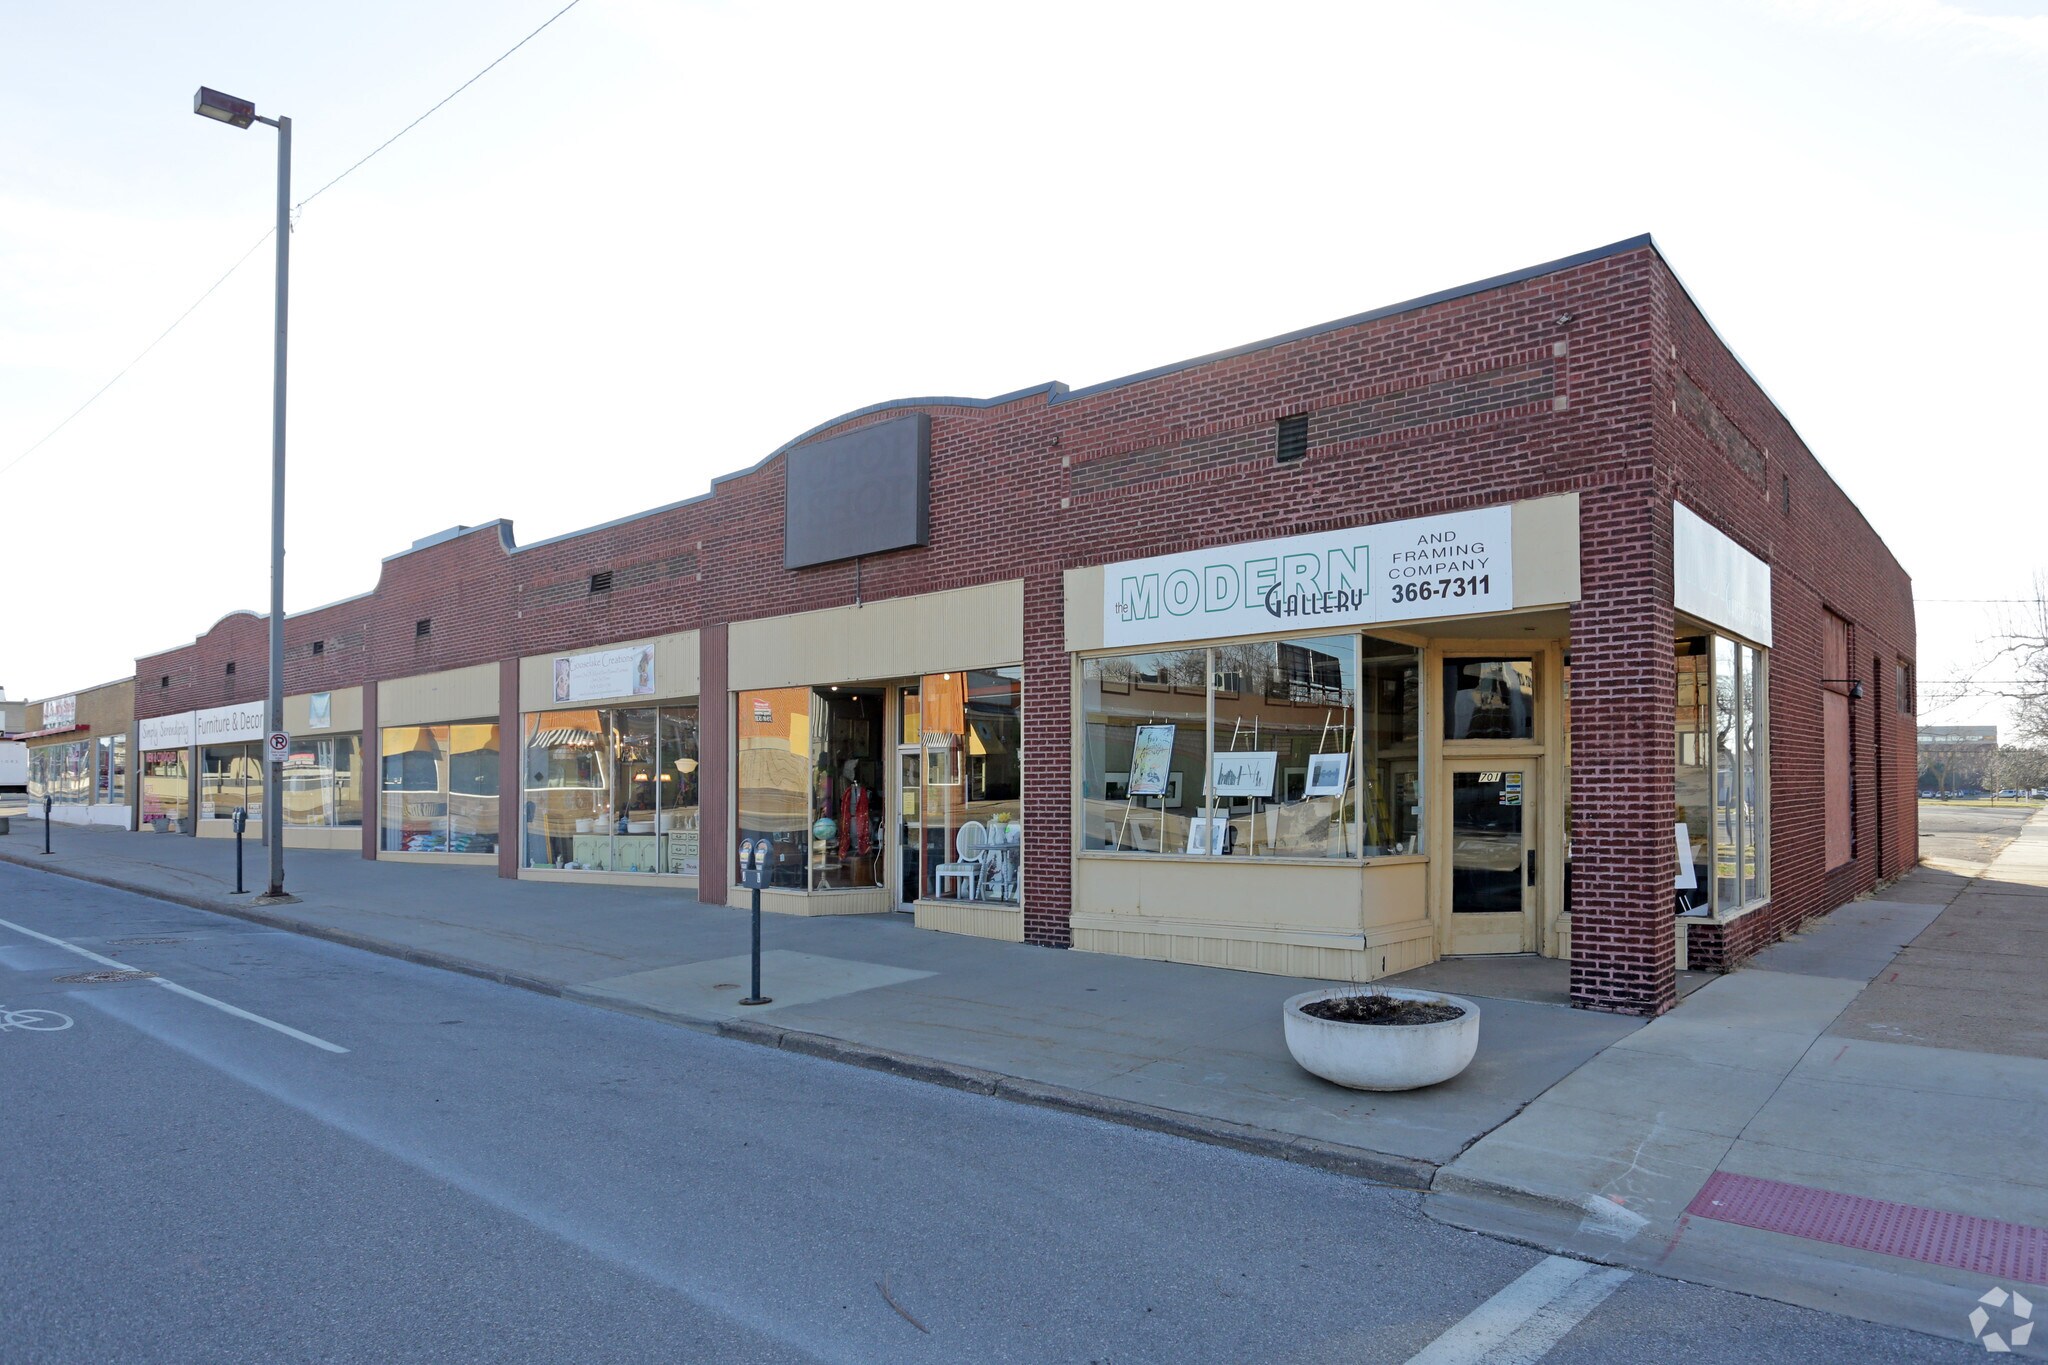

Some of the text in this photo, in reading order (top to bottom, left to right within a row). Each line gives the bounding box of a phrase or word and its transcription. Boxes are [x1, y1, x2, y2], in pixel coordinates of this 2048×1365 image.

[1417, 531, 1456, 546] AND
[1392, 542, 1485, 564] FRAMING
[1388, 557, 1489, 580] COMPANY
[1115, 544, 1369, 622] the MODERN
[1391, 574, 1489, 604] 366-7311
[602, 653, 633, 667] Creations
[142, 718, 189, 746] Simply Serendipity
[198, 711, 263, 735] Furniture & Decor
[1480, 772, 1500, 782] 701
